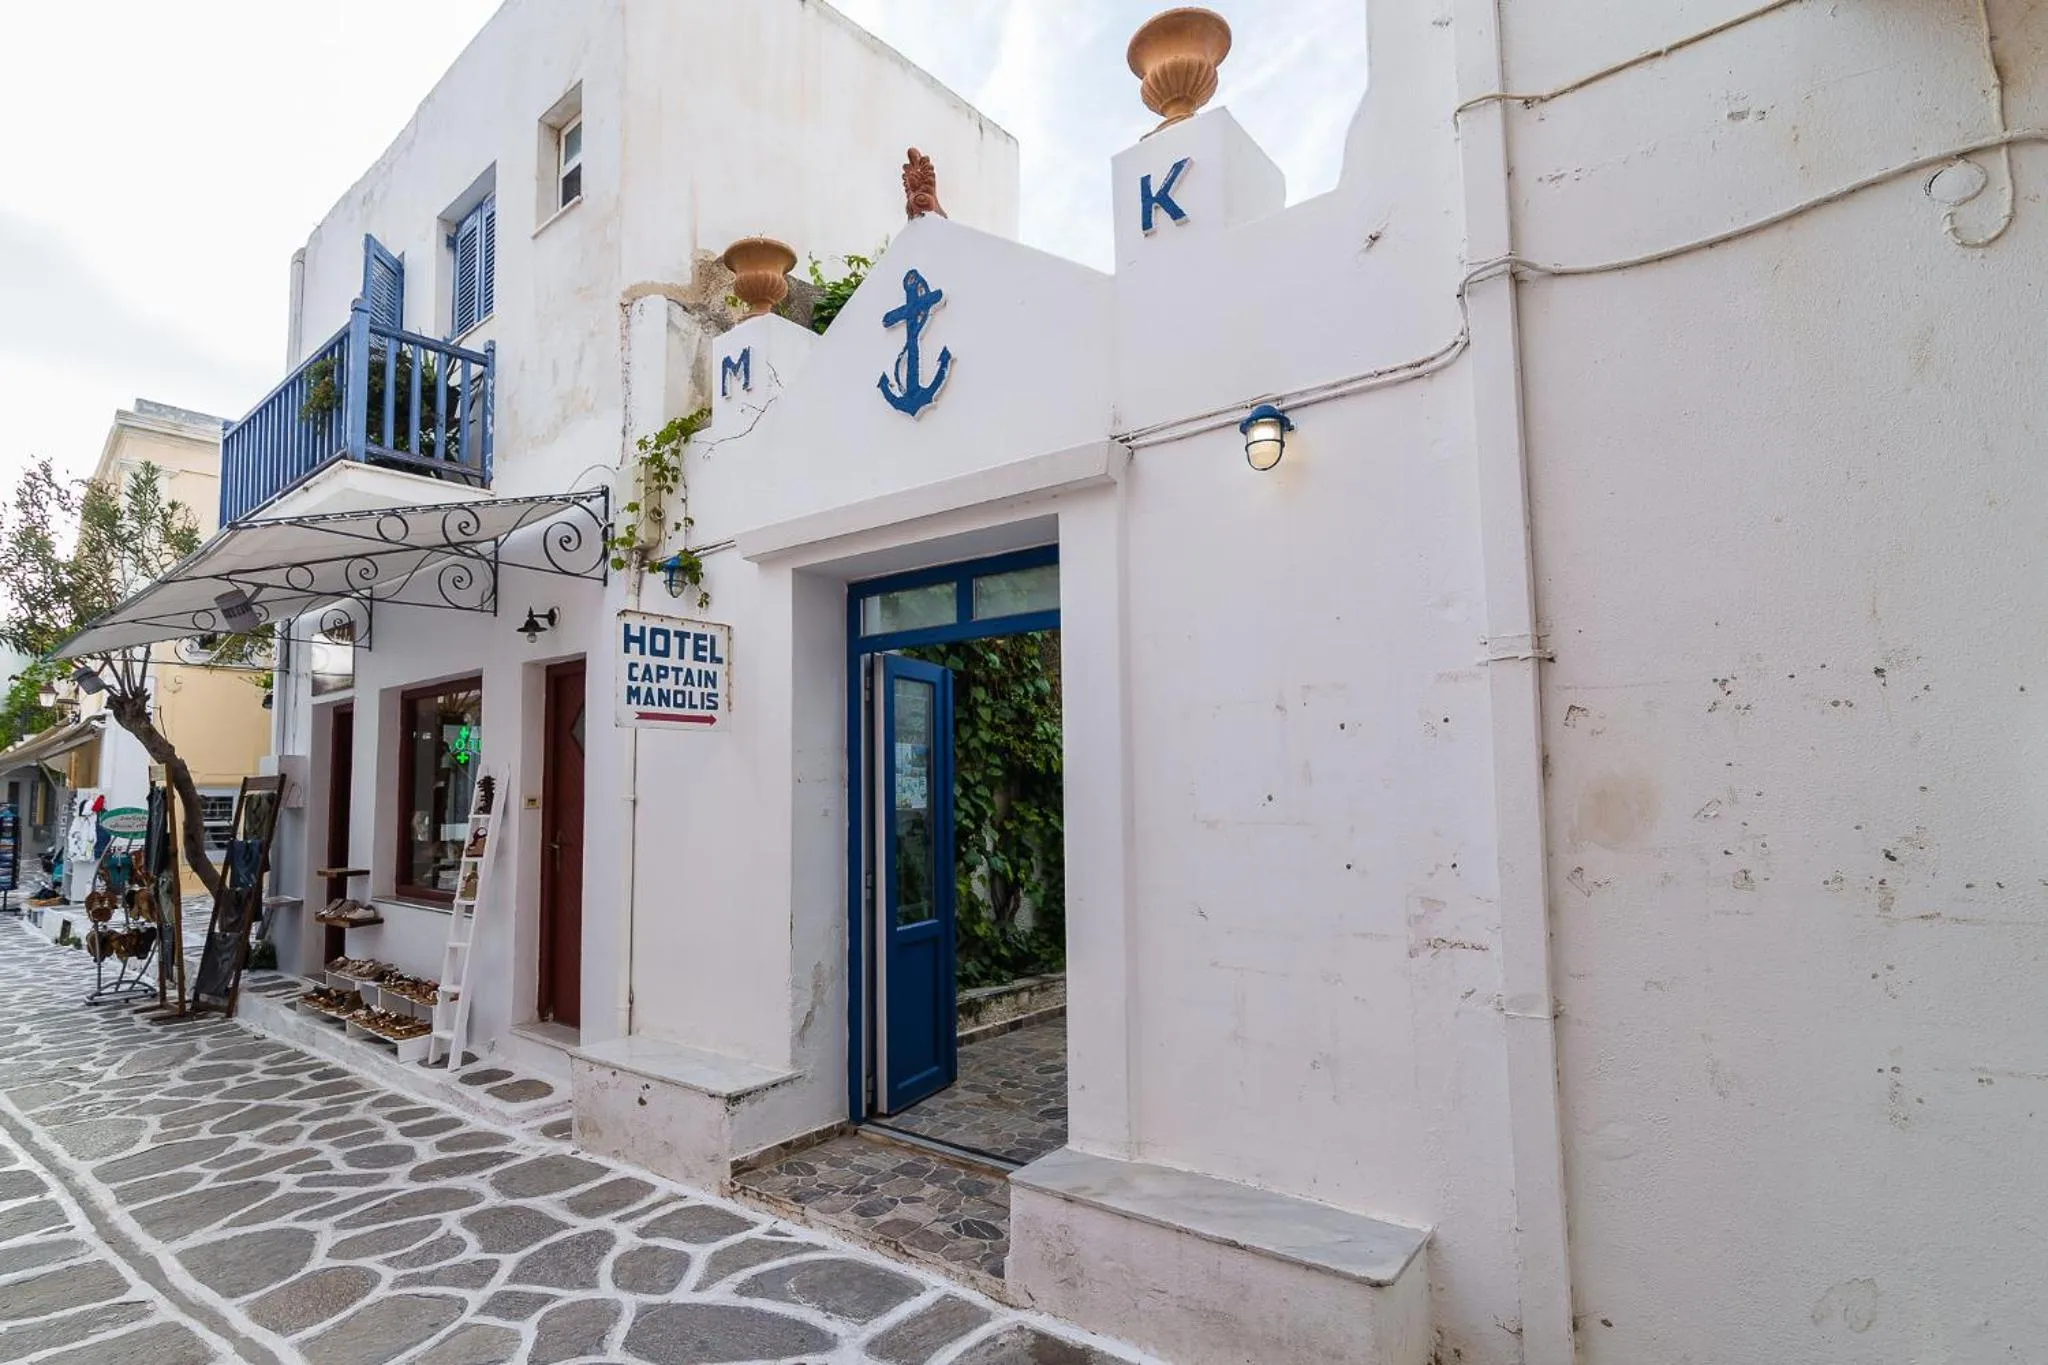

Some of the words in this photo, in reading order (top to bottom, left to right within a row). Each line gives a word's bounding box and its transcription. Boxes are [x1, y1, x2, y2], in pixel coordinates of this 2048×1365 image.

[1140, 156, 1191, 233] K
[721, 345, 751, 397] M
[623, 623, 724, 665] HOTEL
[627, 661, 718, 690] CAPTAIN
[626, 684, 719, 711] MANOLIS
